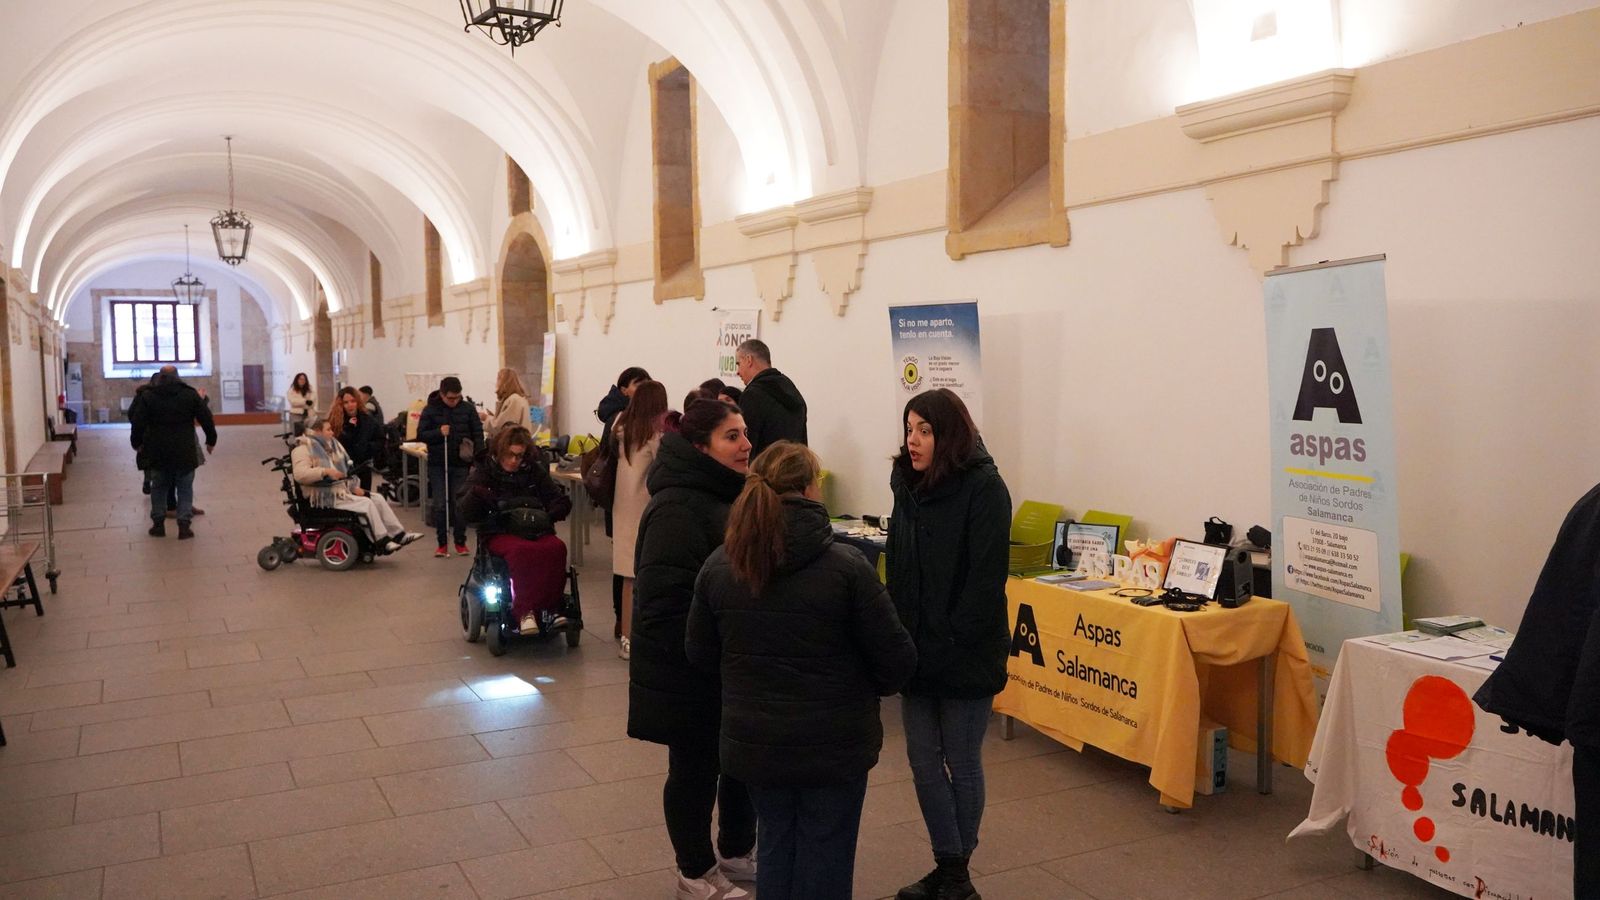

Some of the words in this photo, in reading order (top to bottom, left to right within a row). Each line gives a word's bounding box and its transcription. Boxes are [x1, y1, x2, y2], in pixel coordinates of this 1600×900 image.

[898, 318, 905, 327] Si
[1290, 433, 1366, 465] aspas
[1289, 479, 1328, 492] Asociación
[1330, 486, 1340, 495] de
[1343, 486, 1372, 499] Padres
[1299, 493, 1308, 502] de
[1310, 493, 1330, 506] Niños
[1332, 498, 1363, 511] Sordos
[1307, 506, 1353, 522] Salamanca
[1074, 613, 1121, 647] Aspas
[1056, 650, 1137, 699] Salamanca
[1028, 680, 1034, 689] de
[1035, 682, 1053, 696] Padres
[1054, 689, 1060, 699] de
[1061, 691, 1078, 705] Niños
[1080, 698, 1101, 714] Sordos
[1102, 706, 1109, 716] de
[1110, 709, 1138, 729] Salamanca
